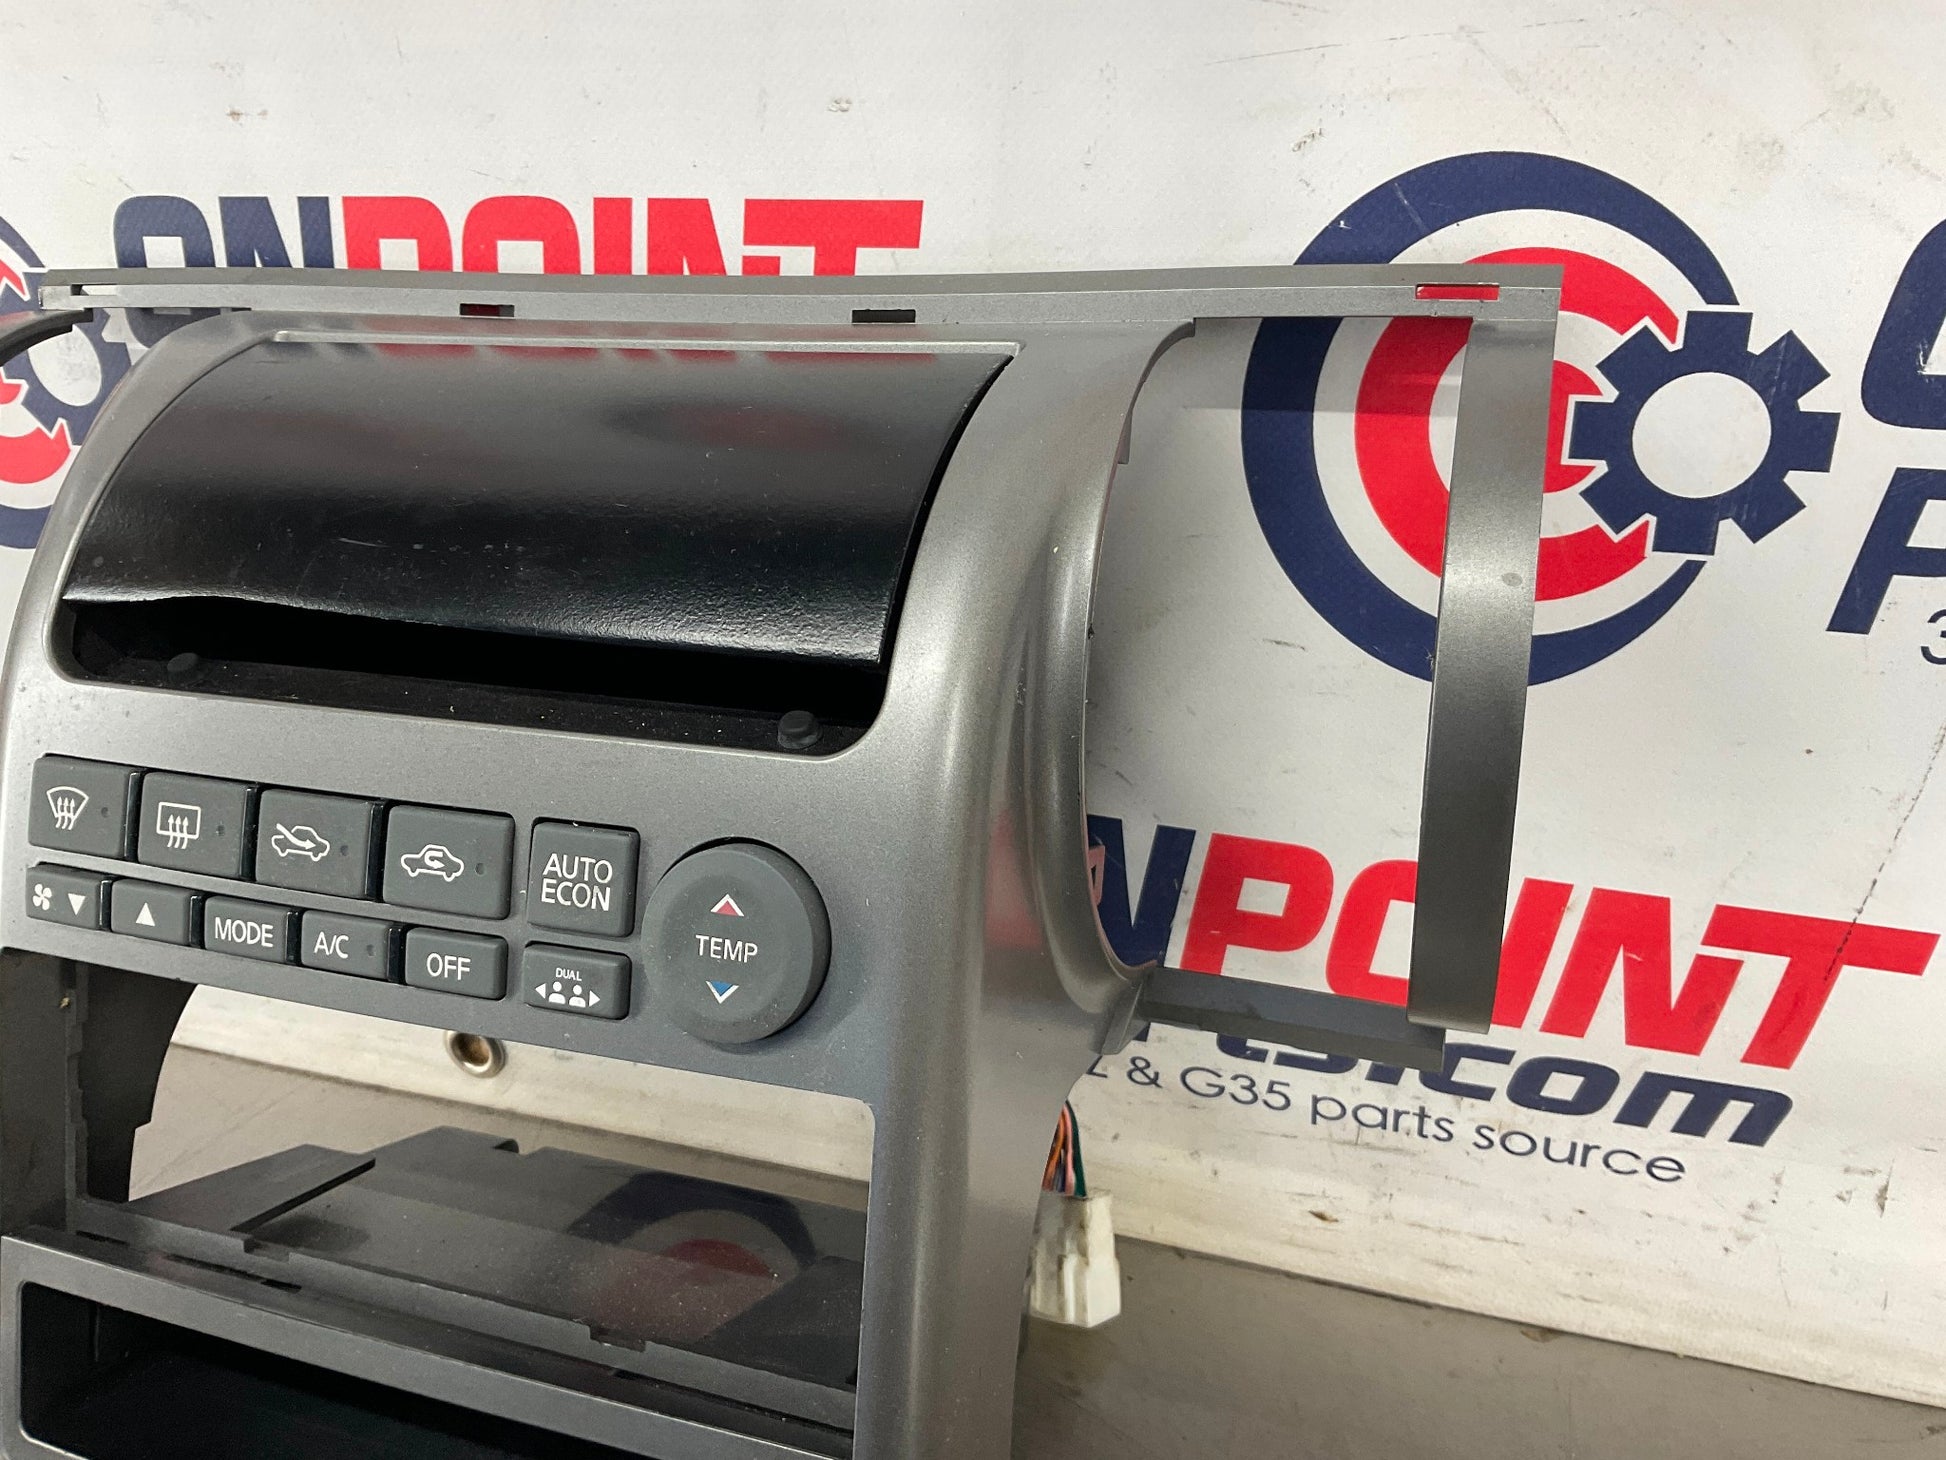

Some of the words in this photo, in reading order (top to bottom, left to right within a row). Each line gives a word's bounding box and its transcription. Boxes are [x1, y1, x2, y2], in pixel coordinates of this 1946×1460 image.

[542, 853, 613, 884] AUTO
[541, 878, 611, 911] ECON
[214, 916, 274, 948] MODE
[314, 931, 350, 959] A/C
[1087, 813, 1941, 1069] NPOINT
[695, 934, 758, 963] TEMP
[426, 952, 471, 980] OFF
[555, 967, 582, 982] DUAL
[1126, 1056, 1164, 1090] &
[1180, 1066, 1292, 1112] G35
[1311, 1093, 1455, 1143] parts
[1473, 1122, 1687, 1184] source
